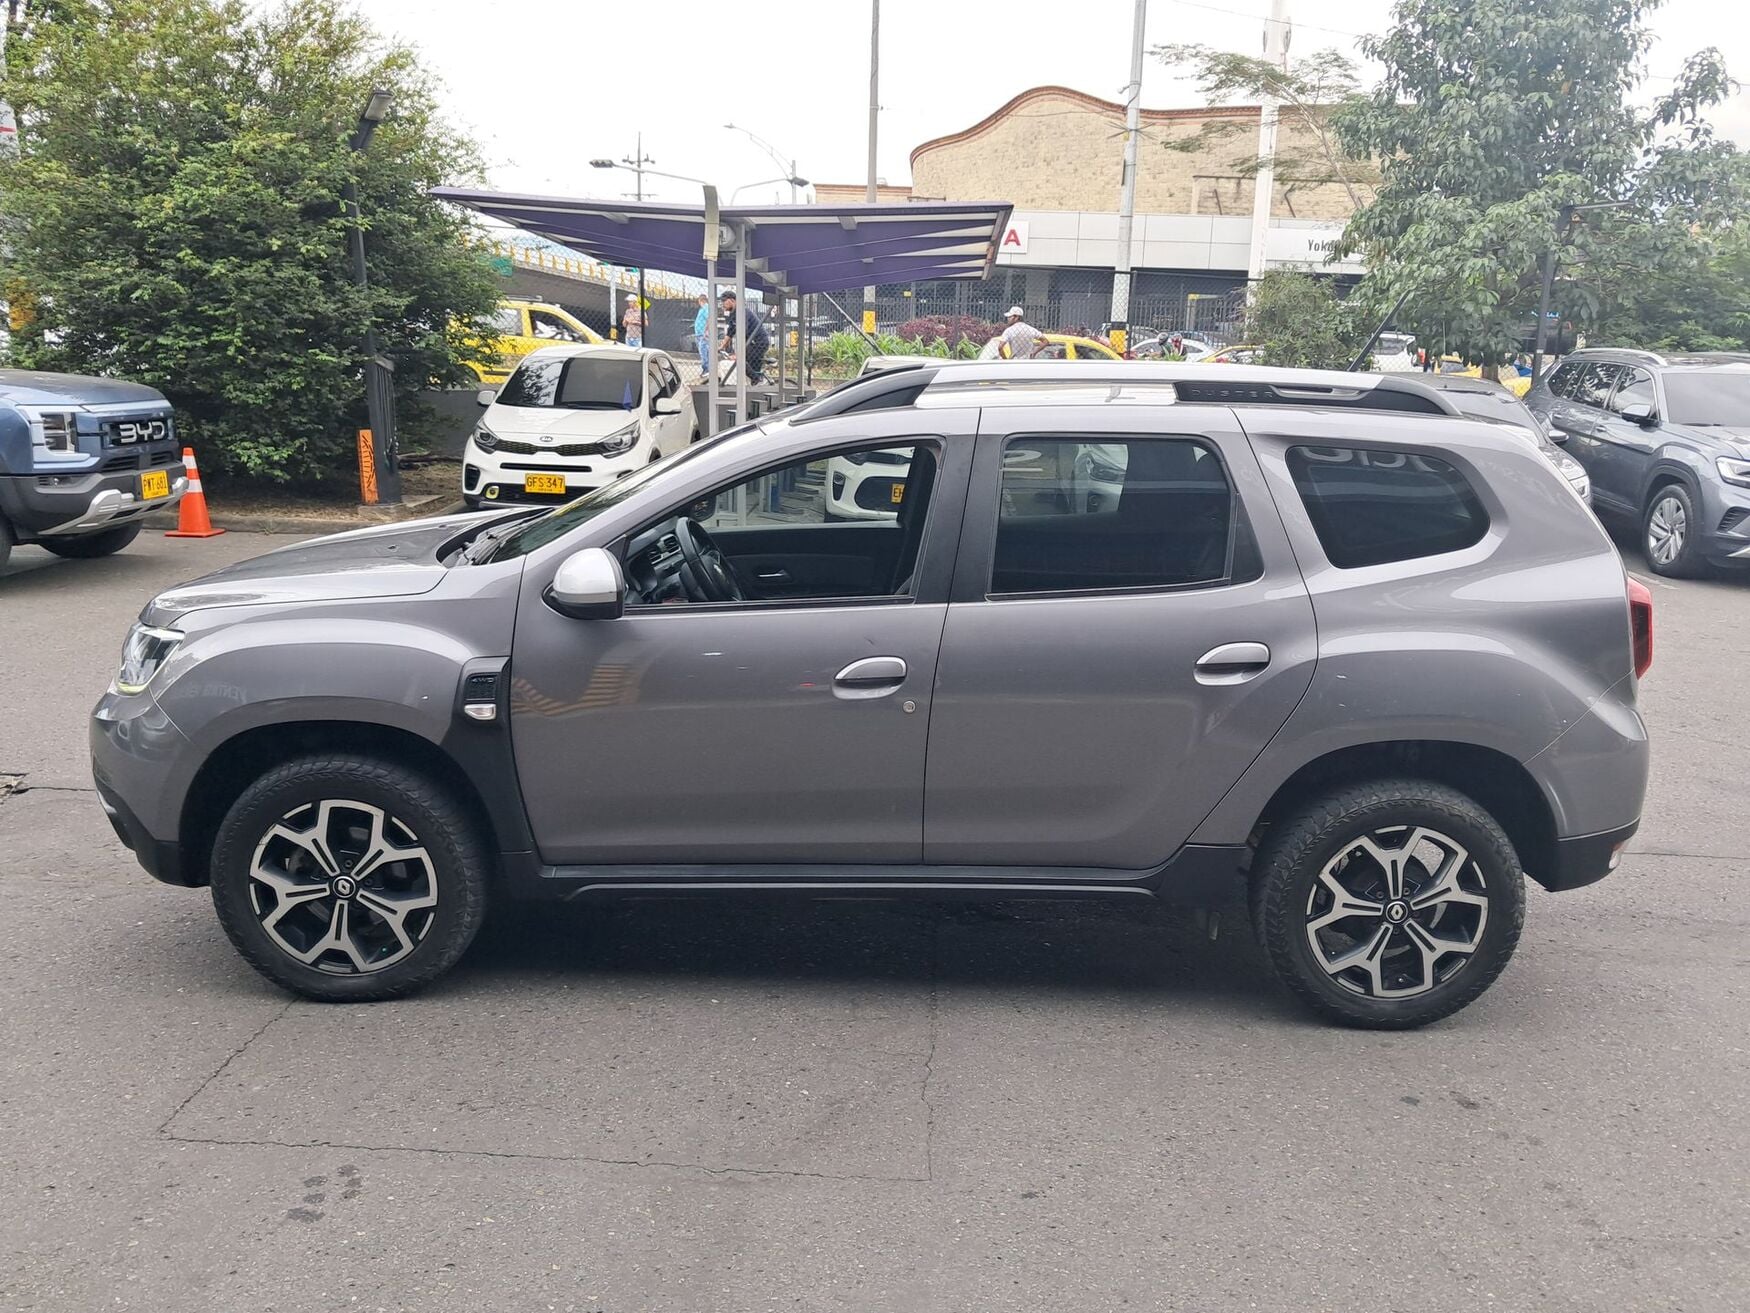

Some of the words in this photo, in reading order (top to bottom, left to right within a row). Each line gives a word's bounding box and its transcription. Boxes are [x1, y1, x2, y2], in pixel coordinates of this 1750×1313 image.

[119, 421, 165, 443] BYD
[526, 476, 544, 488] GFS
[546, 477, 564, 489] 347
